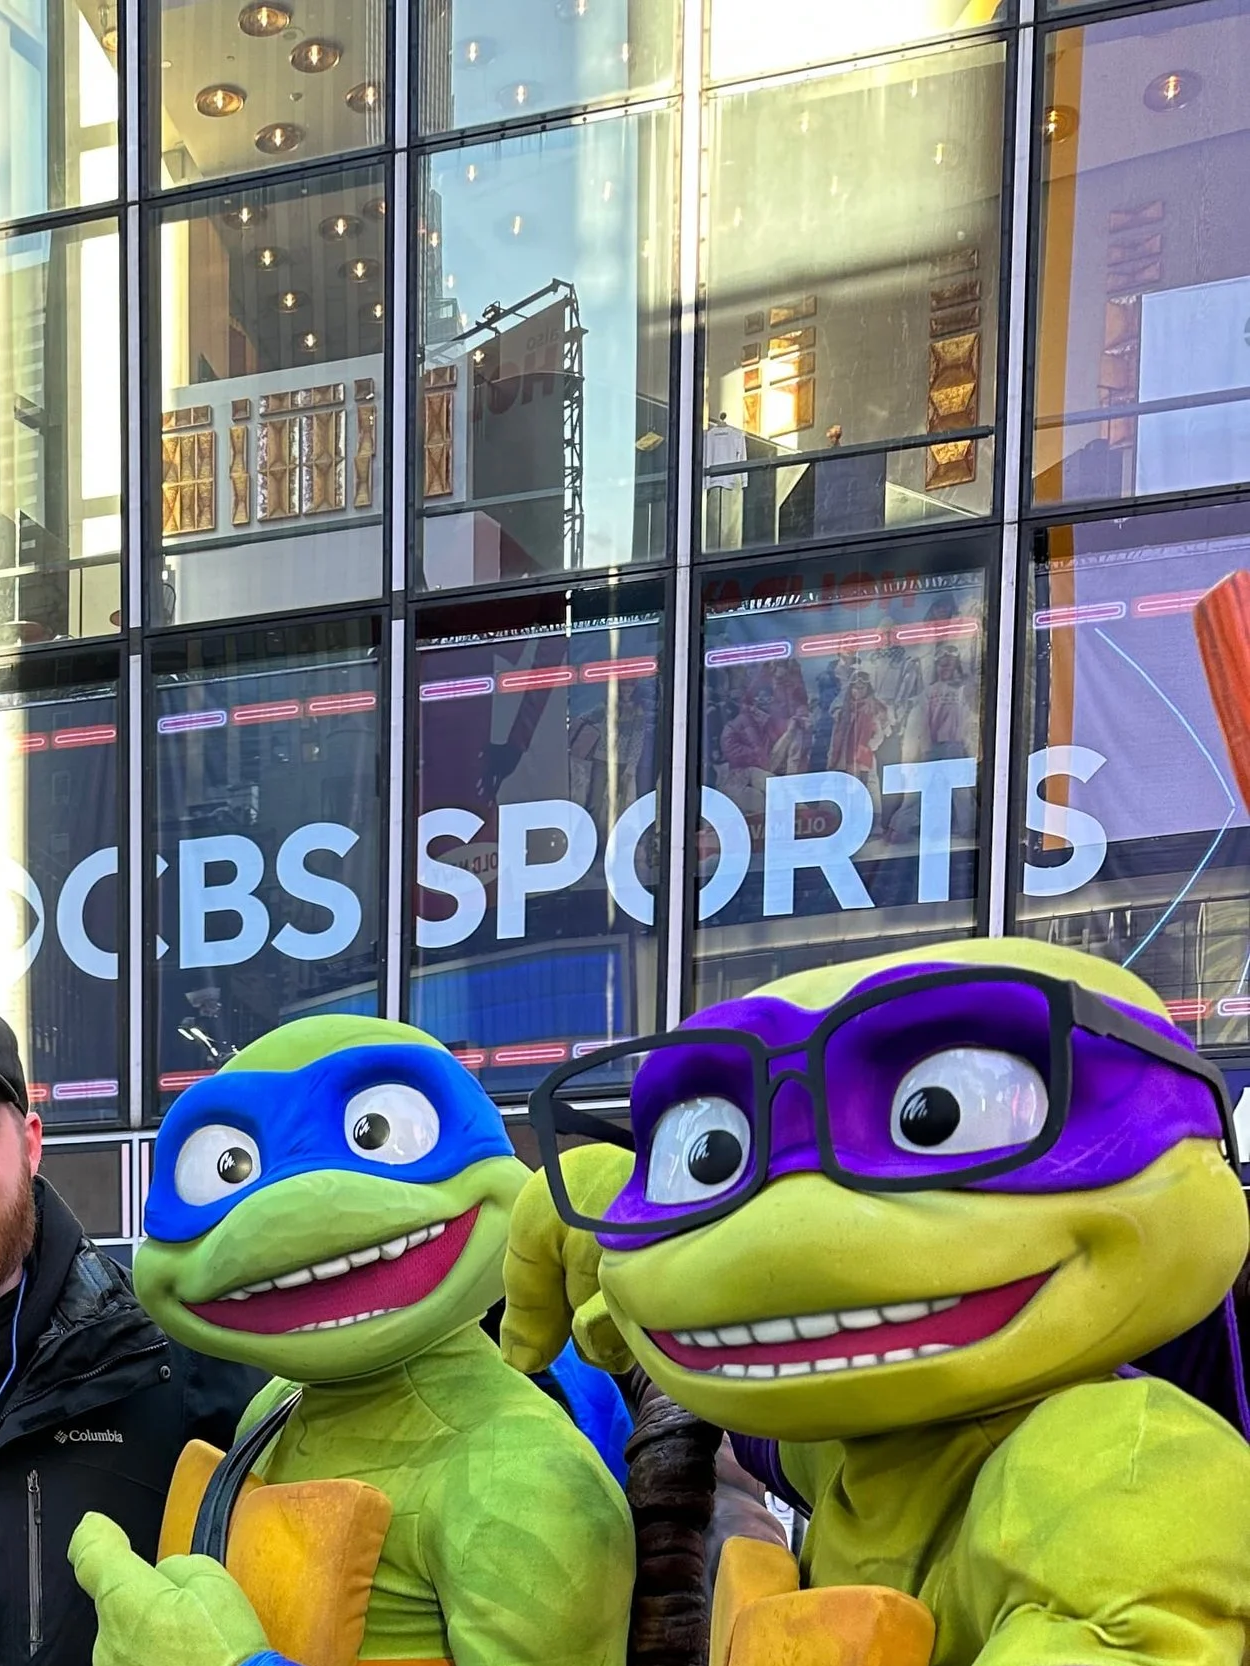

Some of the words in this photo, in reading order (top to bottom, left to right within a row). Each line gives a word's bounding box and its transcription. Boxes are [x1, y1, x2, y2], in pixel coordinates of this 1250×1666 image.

[56, 822, 363, 980] CBS
[415, 744, 1109, 949] SPORTS
[69, 1429, 123, 1443] Columbia
